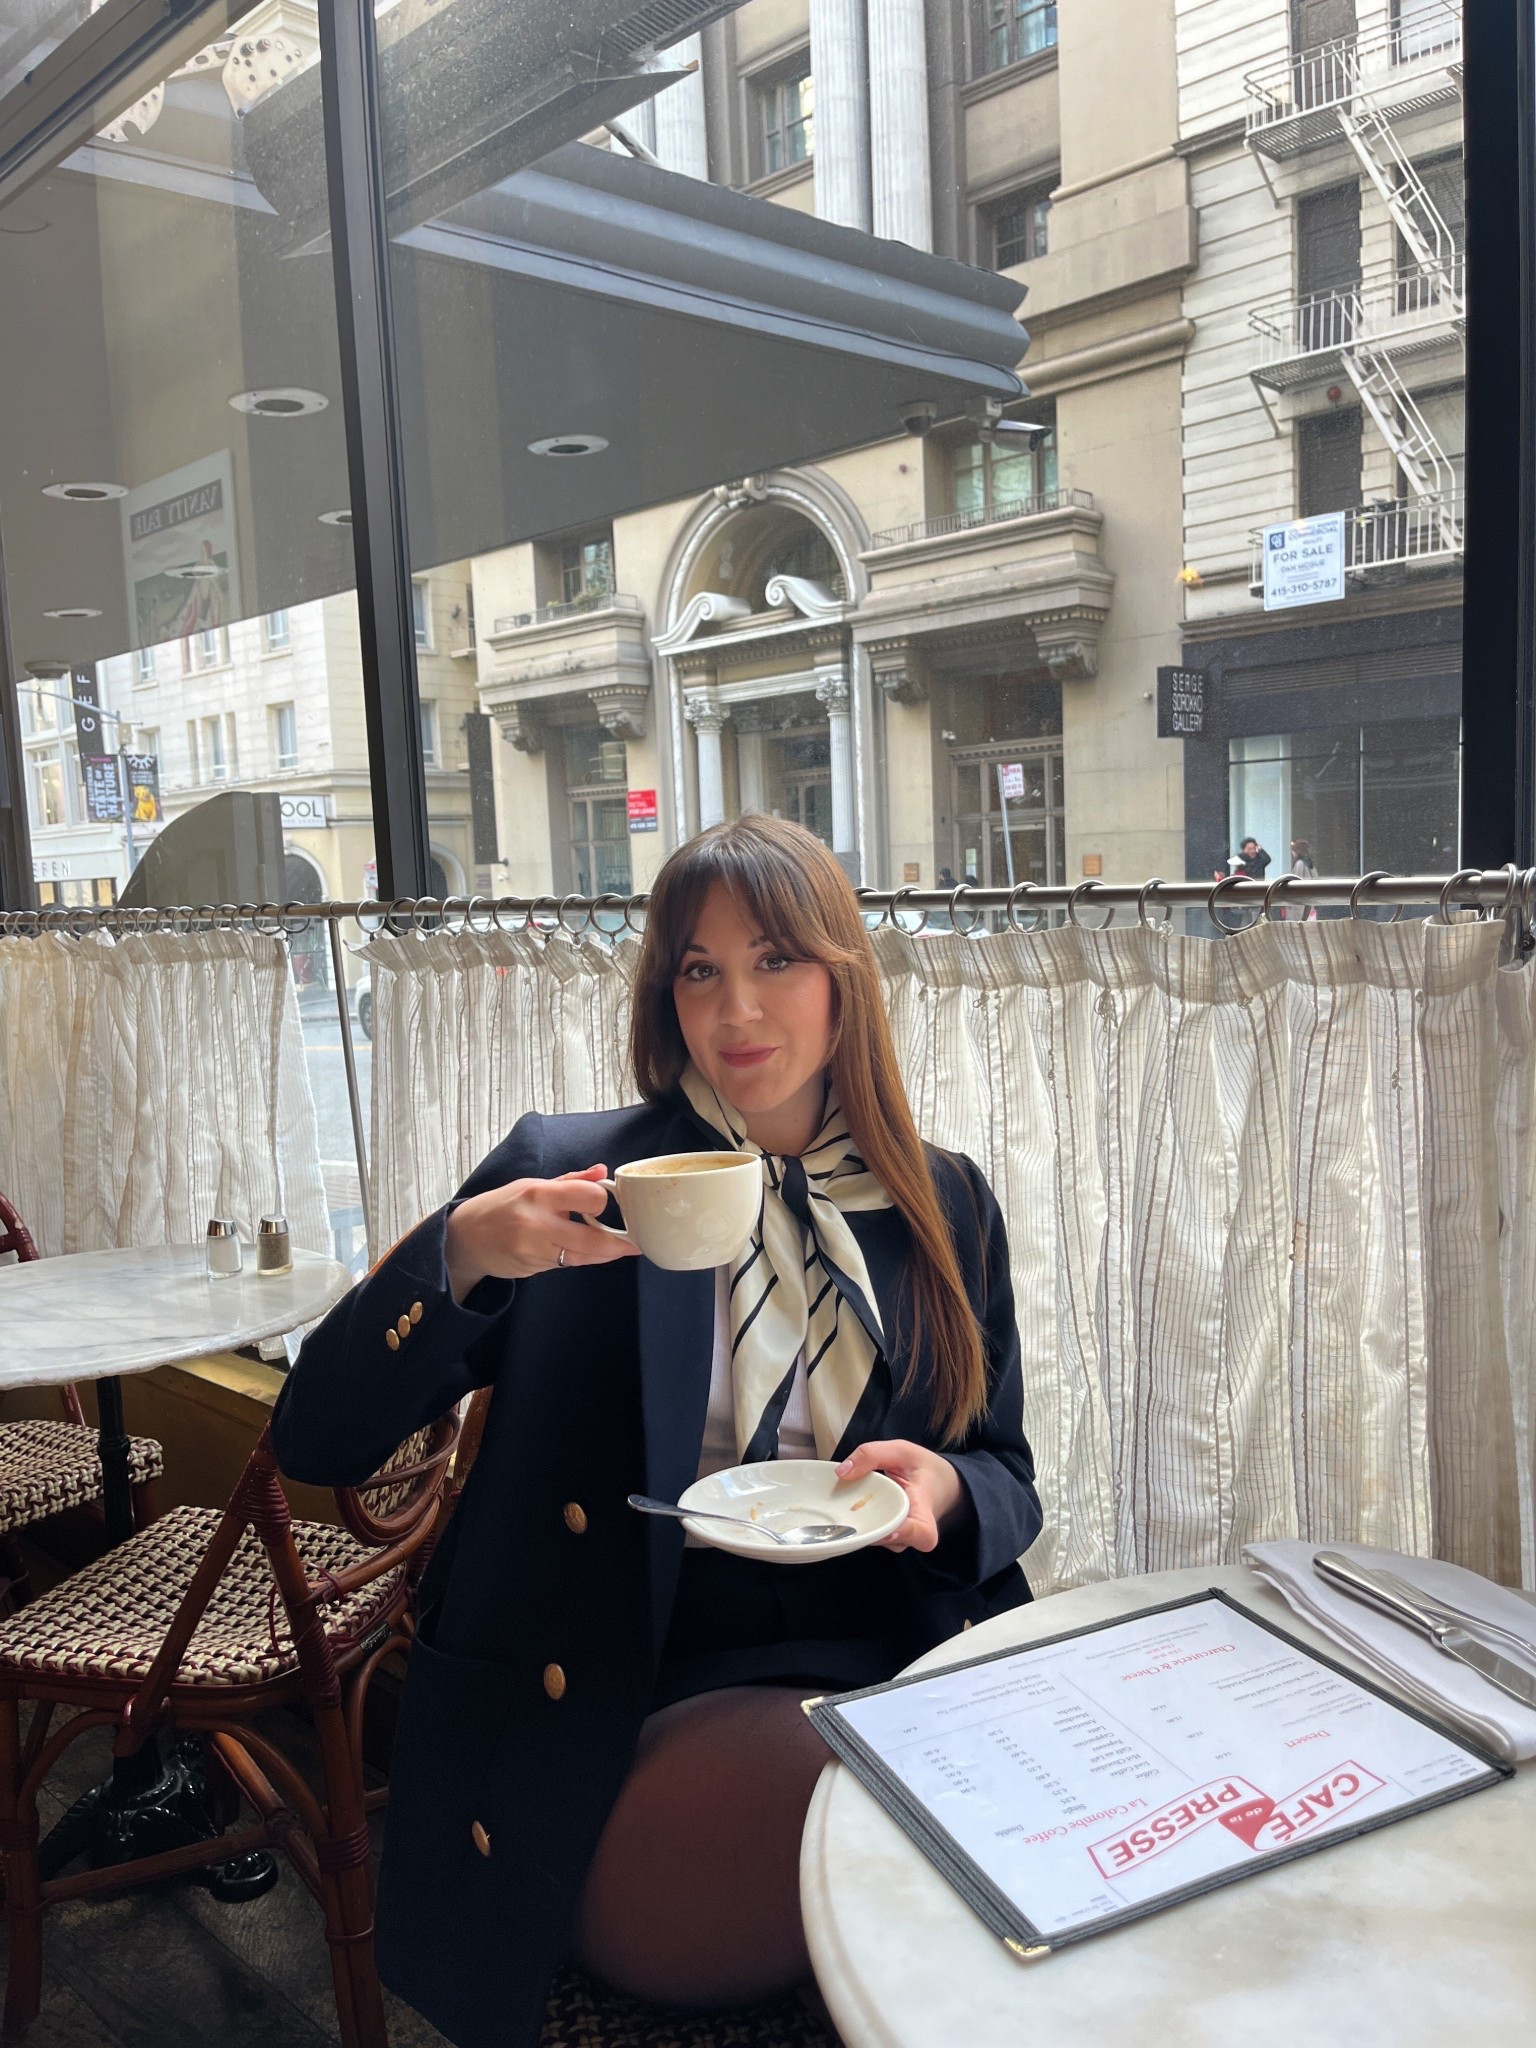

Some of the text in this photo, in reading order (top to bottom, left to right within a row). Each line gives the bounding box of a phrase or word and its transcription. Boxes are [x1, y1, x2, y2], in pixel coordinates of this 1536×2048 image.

[1273, 543, 1333, 564] FOR SALE
[1172, 672, 1203, 693] SERGE
[1172, 712, 1202, 731] GALLERY
[103, 762, 118, 815] NATURE
[94, 780, 108, 820] STATE
[1171, 1644, 1235, 1665] Charcuterie
[1120, 1666, 1160, 1680] Cheese
[1053, 1712, 1089, 1725] Macchiato
[1056, 1705, 1081, 1714] Mocha
[1058, 1718, 1096, 1732] Americano
[1087, 1725, 1106, 1733] Latte
[1072, 1732, 1114, 1747] Cappuccino
[1091, 1738, 1124, 1751] Espresso
[1283, 1729, 1330, 1748] Dessert
[1114, 1746, 1131, 1754] Café
[1089, 1758, 1126, 1772] Chocolate
[1043, 1779, 1060, 1788] 5.20
[1051, 1760, 1150, 1796] Iced Coffee 4.25
[1060, 1768, 1159, 1804] Coffee 4.25
[1230, 1807, 1263, 1824] de la
[1269, 1773, 1360, 1842] CAFÉ
[994, 1803, 1086, 1836] Single Double
[1022, 1798, 1148, 1843] La Colombe Coffee
[1106, 1783, 1243, 1867] PRESSE
